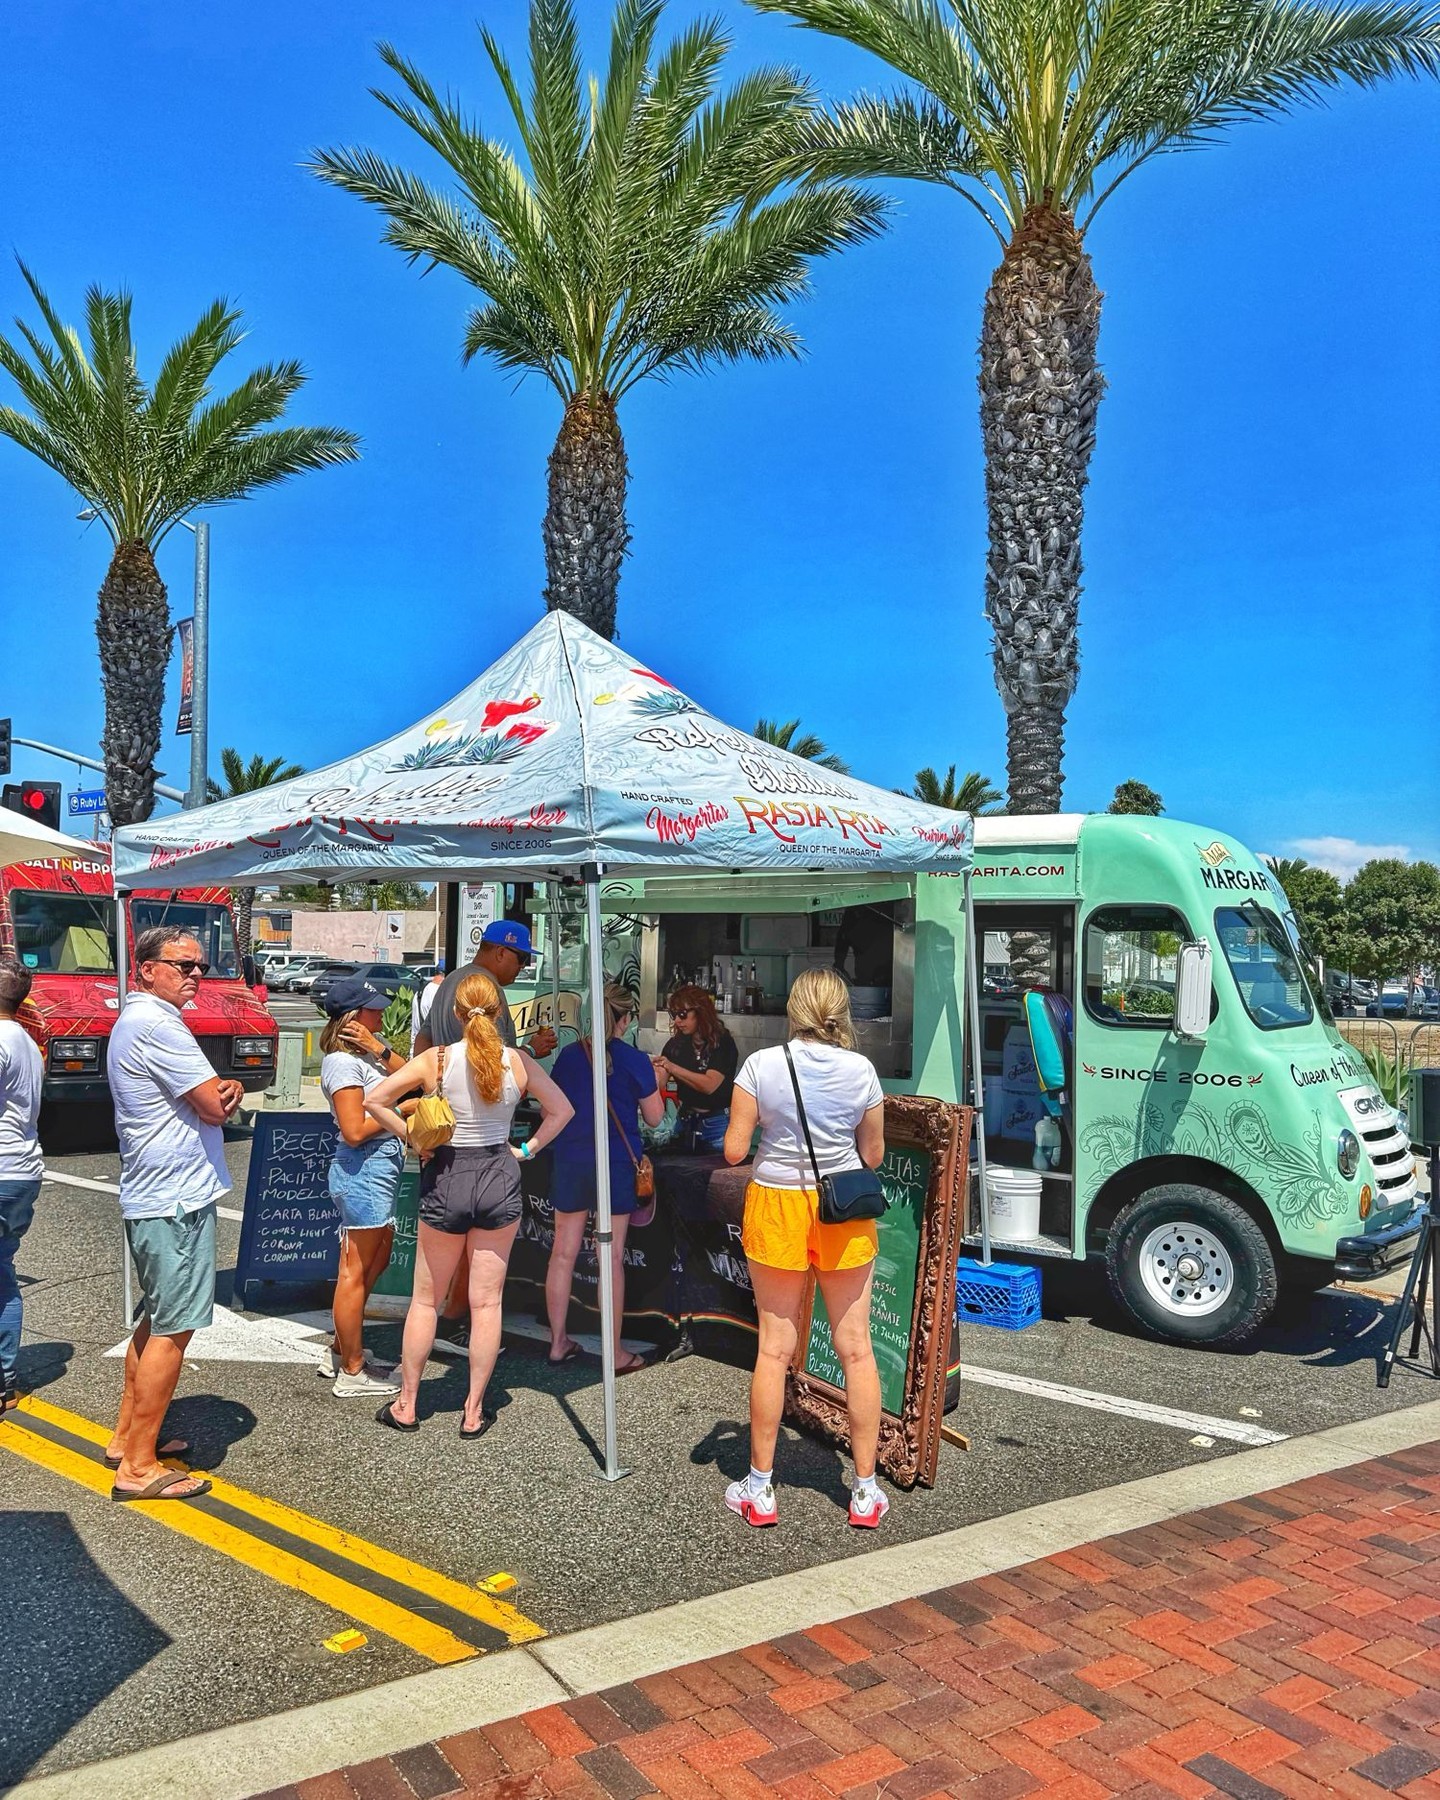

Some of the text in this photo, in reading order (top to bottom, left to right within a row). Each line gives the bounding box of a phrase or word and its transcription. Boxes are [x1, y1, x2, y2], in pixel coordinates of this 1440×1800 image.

[80, 798, 97, 810] Ruby
[621, 790, 694, 806] HAND CRAFTED
[518, 801, 568, 833] Love
[646, 801, 729, 846] Margaritas
[733, 796, 896, 850] RASTA RITA
[135, 834, 157, 842] HAND
[491, 839, 552, 852] SINCE 2006
[262, 843, 389, 859] QUEEN OF THE MARGARITA
[779, 844, 881, 858] QUEEN OF THE MARGARITA
[928, 866, 1065, 878] RASARITA.COM
[1200, 867, 1280, 894] MARGAR
[513, 1001, 567, 1031] Mobie
[1101, 1067, 1242, 1088] SINCE 2006
[1290, 1063, 1330, 1087] Queen
[268, 1167, 327, 1186] PACIFIC
[262, 1188, 330, 1201] MODELO
[260, 1207, 303, 1221] CARTA
[261, 1225, 331, 1238] COORS LIGHT
[261, 1239, 304, 1251] CORONA
[263, 1249, 328, 1263] CORONA LIGHT
[872, 1280, 897, 1296] ASSIC
[870, 1306, 901, 1327] RANATE
